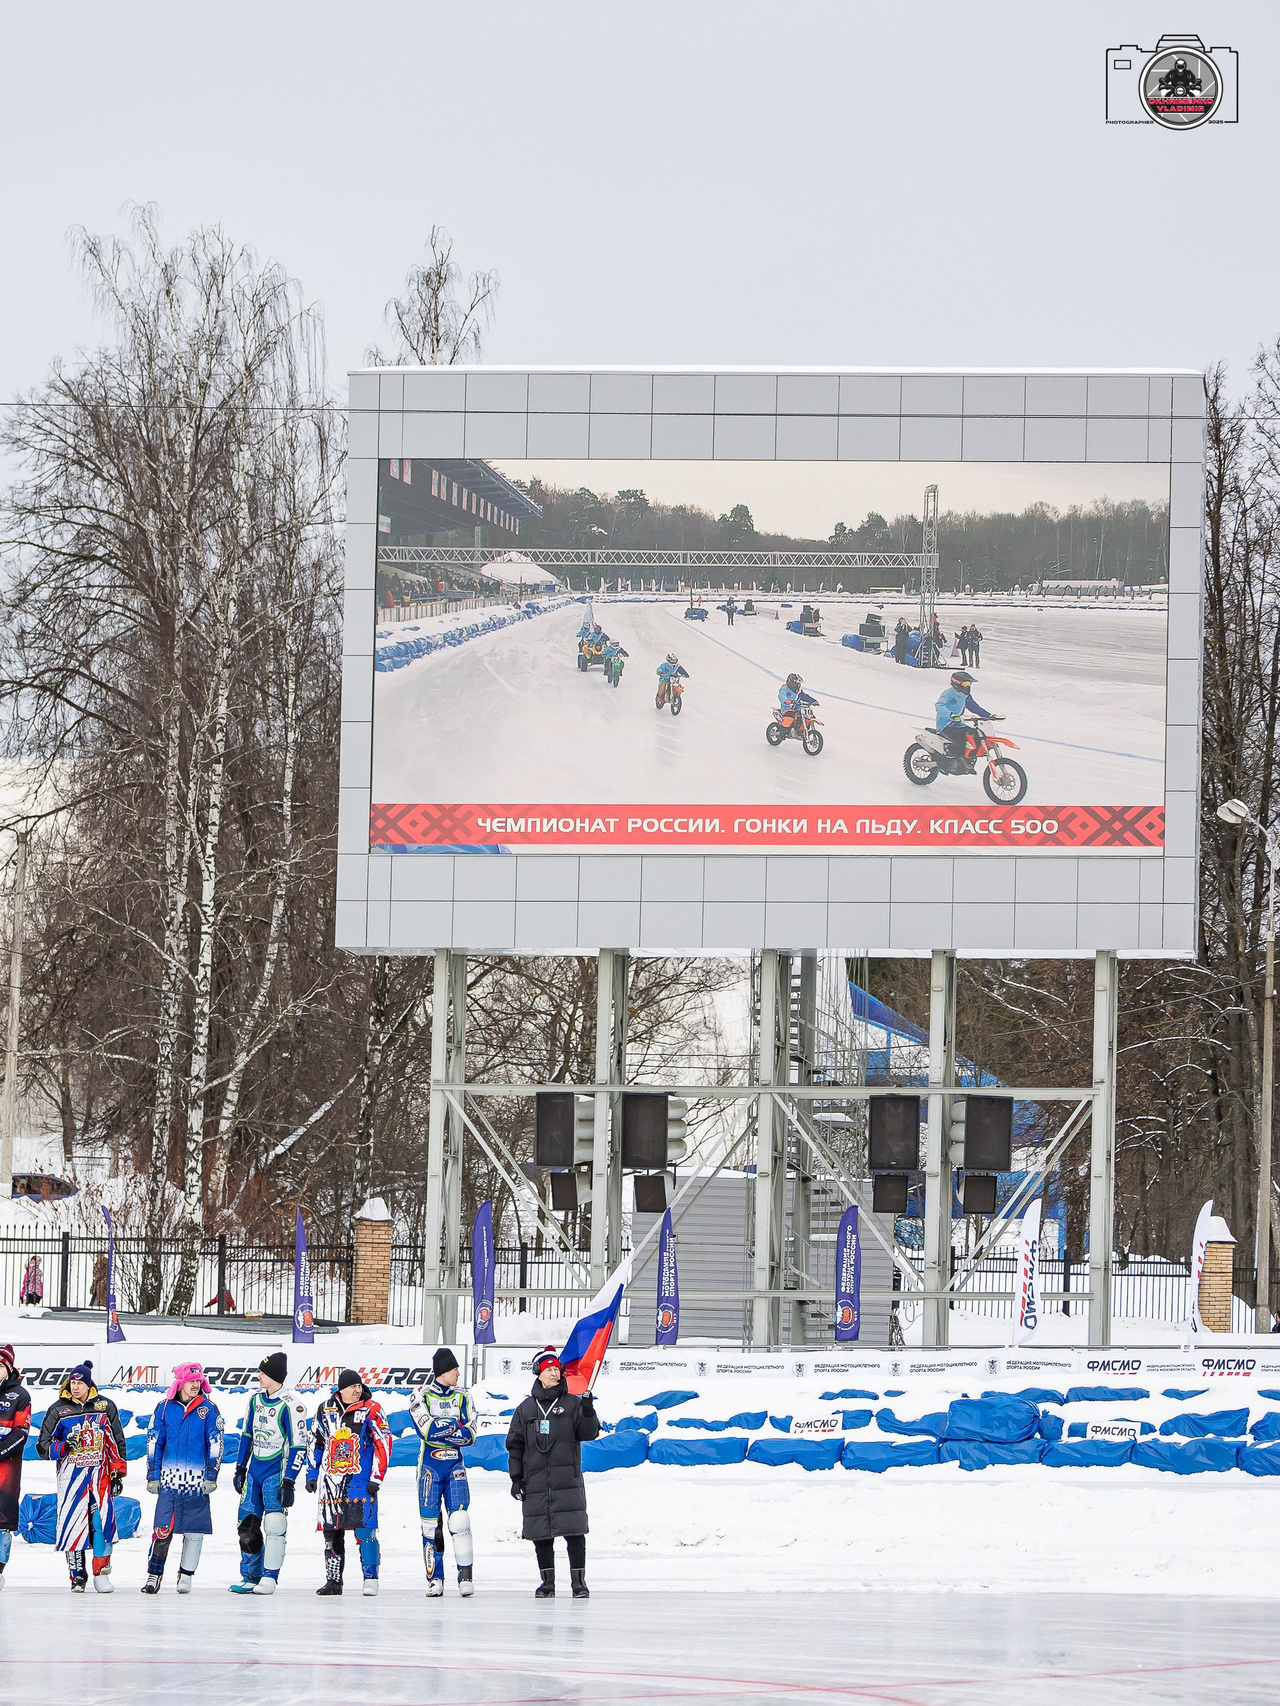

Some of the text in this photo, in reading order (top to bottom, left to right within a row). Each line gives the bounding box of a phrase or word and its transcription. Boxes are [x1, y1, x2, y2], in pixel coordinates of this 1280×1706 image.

[477, 817, 1059, 836] ЧЕМПИОНАТ РОССИИ. ГОНКИ НА ЛЬДУ. КЛАСС 500
[1087, 1360, 1142, 1371] ФМСМО
[1202, 1359, 1256, 1370] ФМСМО
[354, 1411, 366, 1423] 84
[1091, 1425, 1136, 1436] ФМСМО
[292, 1450, 306, 1471] UFA
